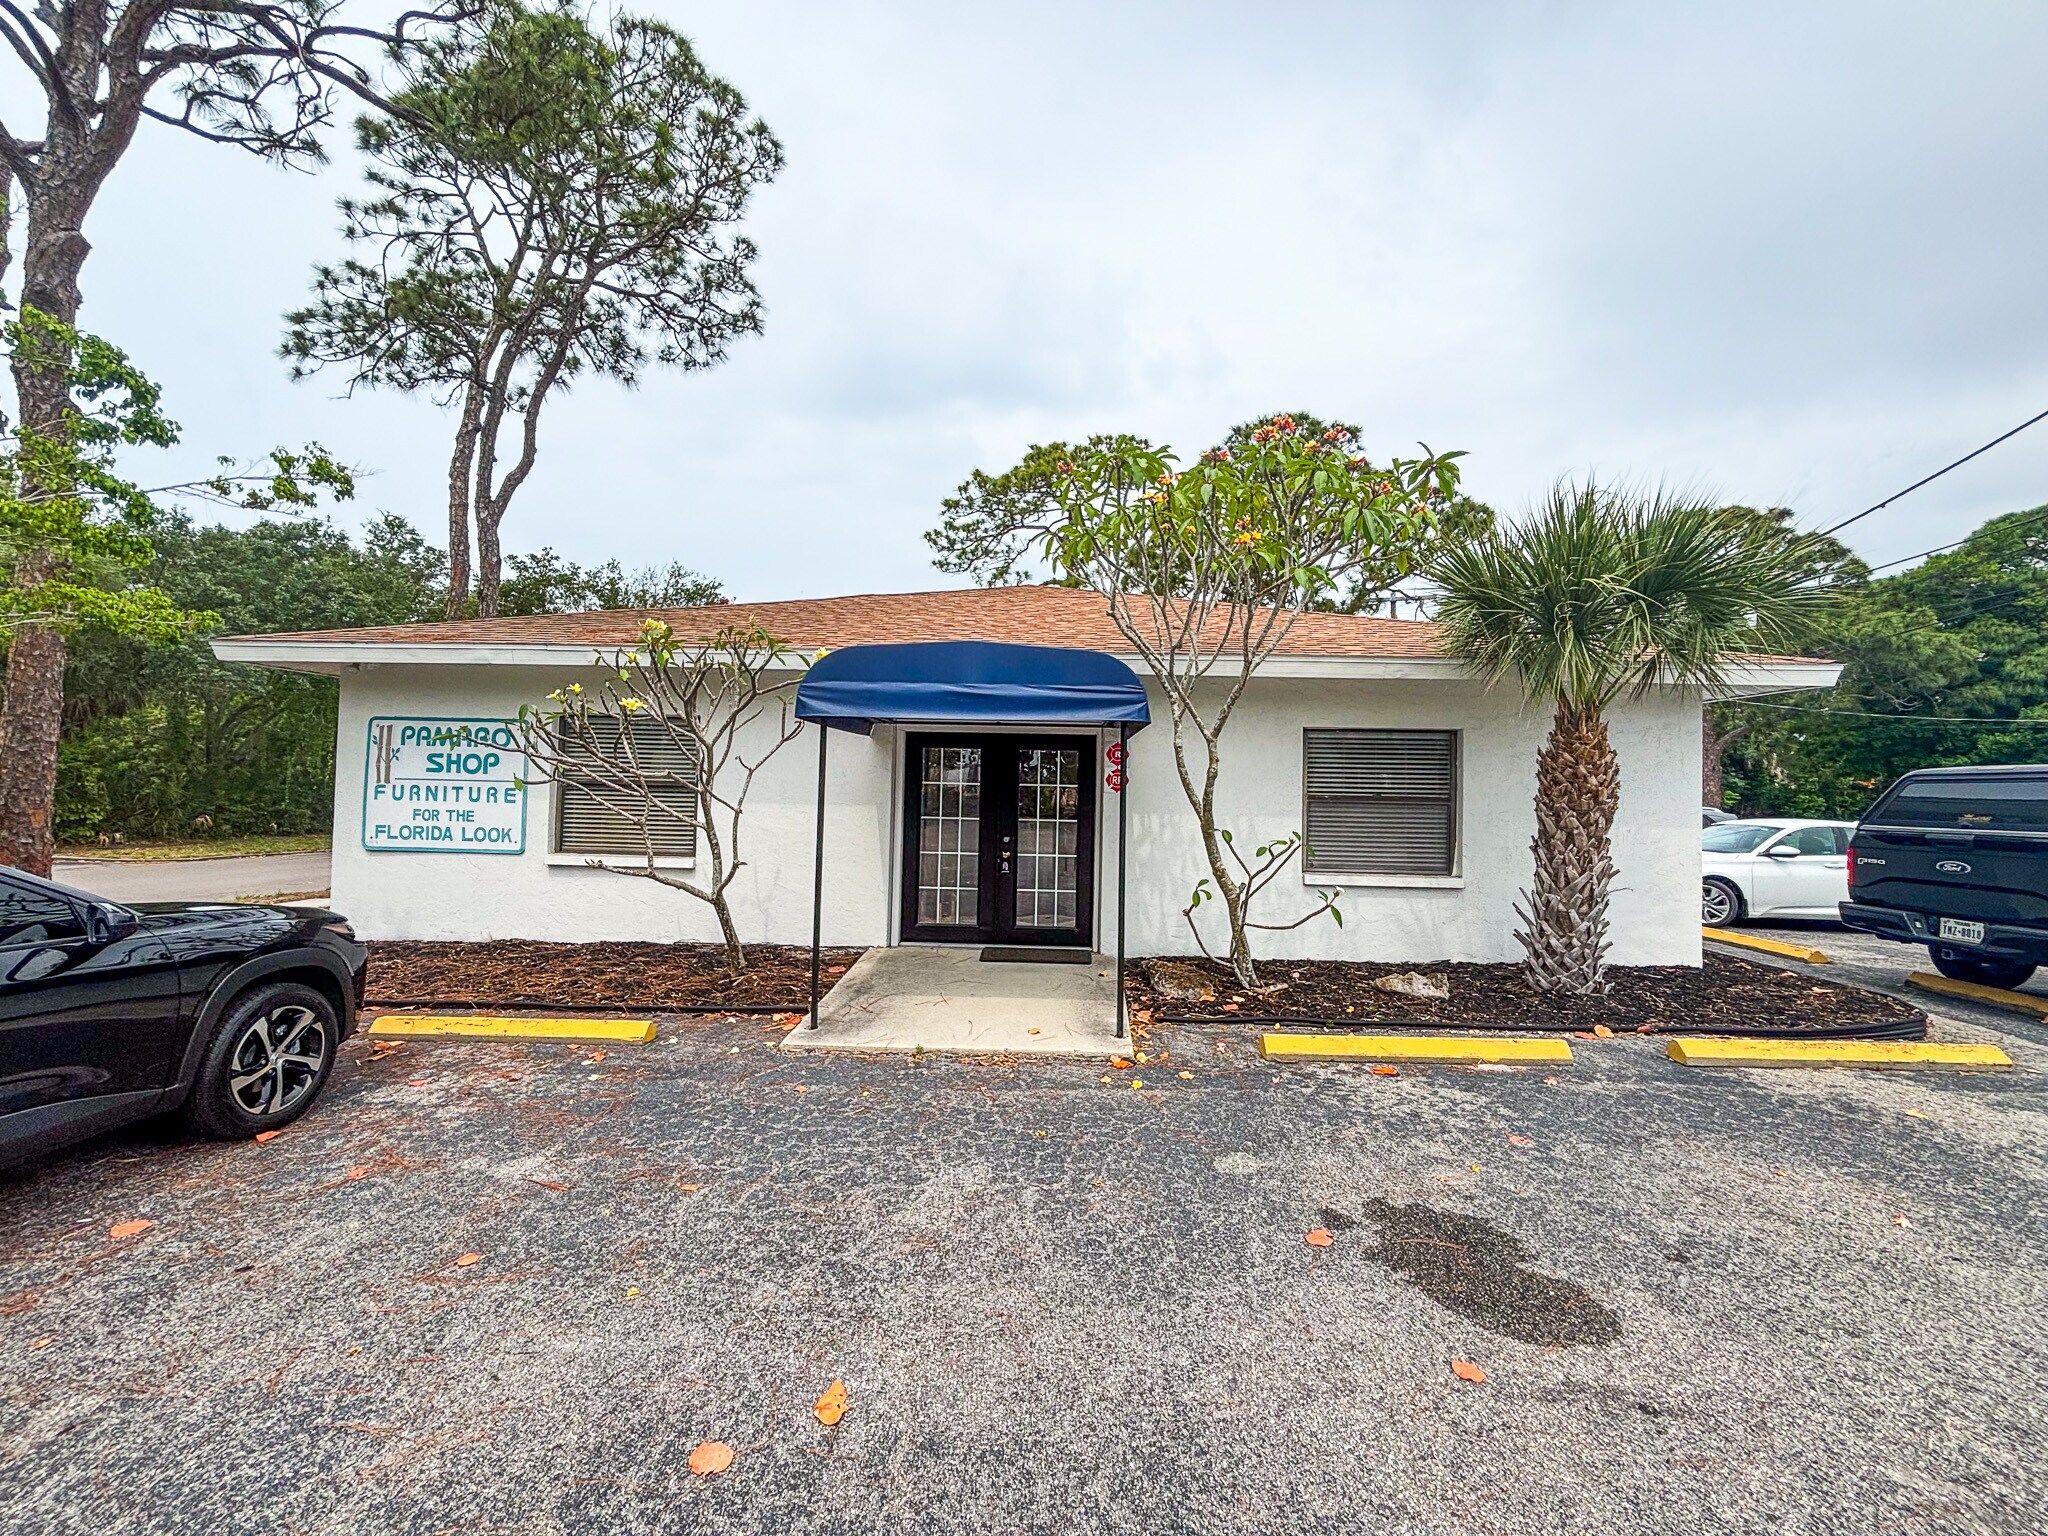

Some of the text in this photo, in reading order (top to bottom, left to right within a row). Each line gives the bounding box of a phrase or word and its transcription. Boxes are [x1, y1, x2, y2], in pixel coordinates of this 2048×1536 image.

[426, 753, 500, 774] SHOP
[374, 784, 516, 803] FURNITURE
[412, 808, 475, 823] FOR THE
[375, 824, 513, 843] FLORIDA LOOK
